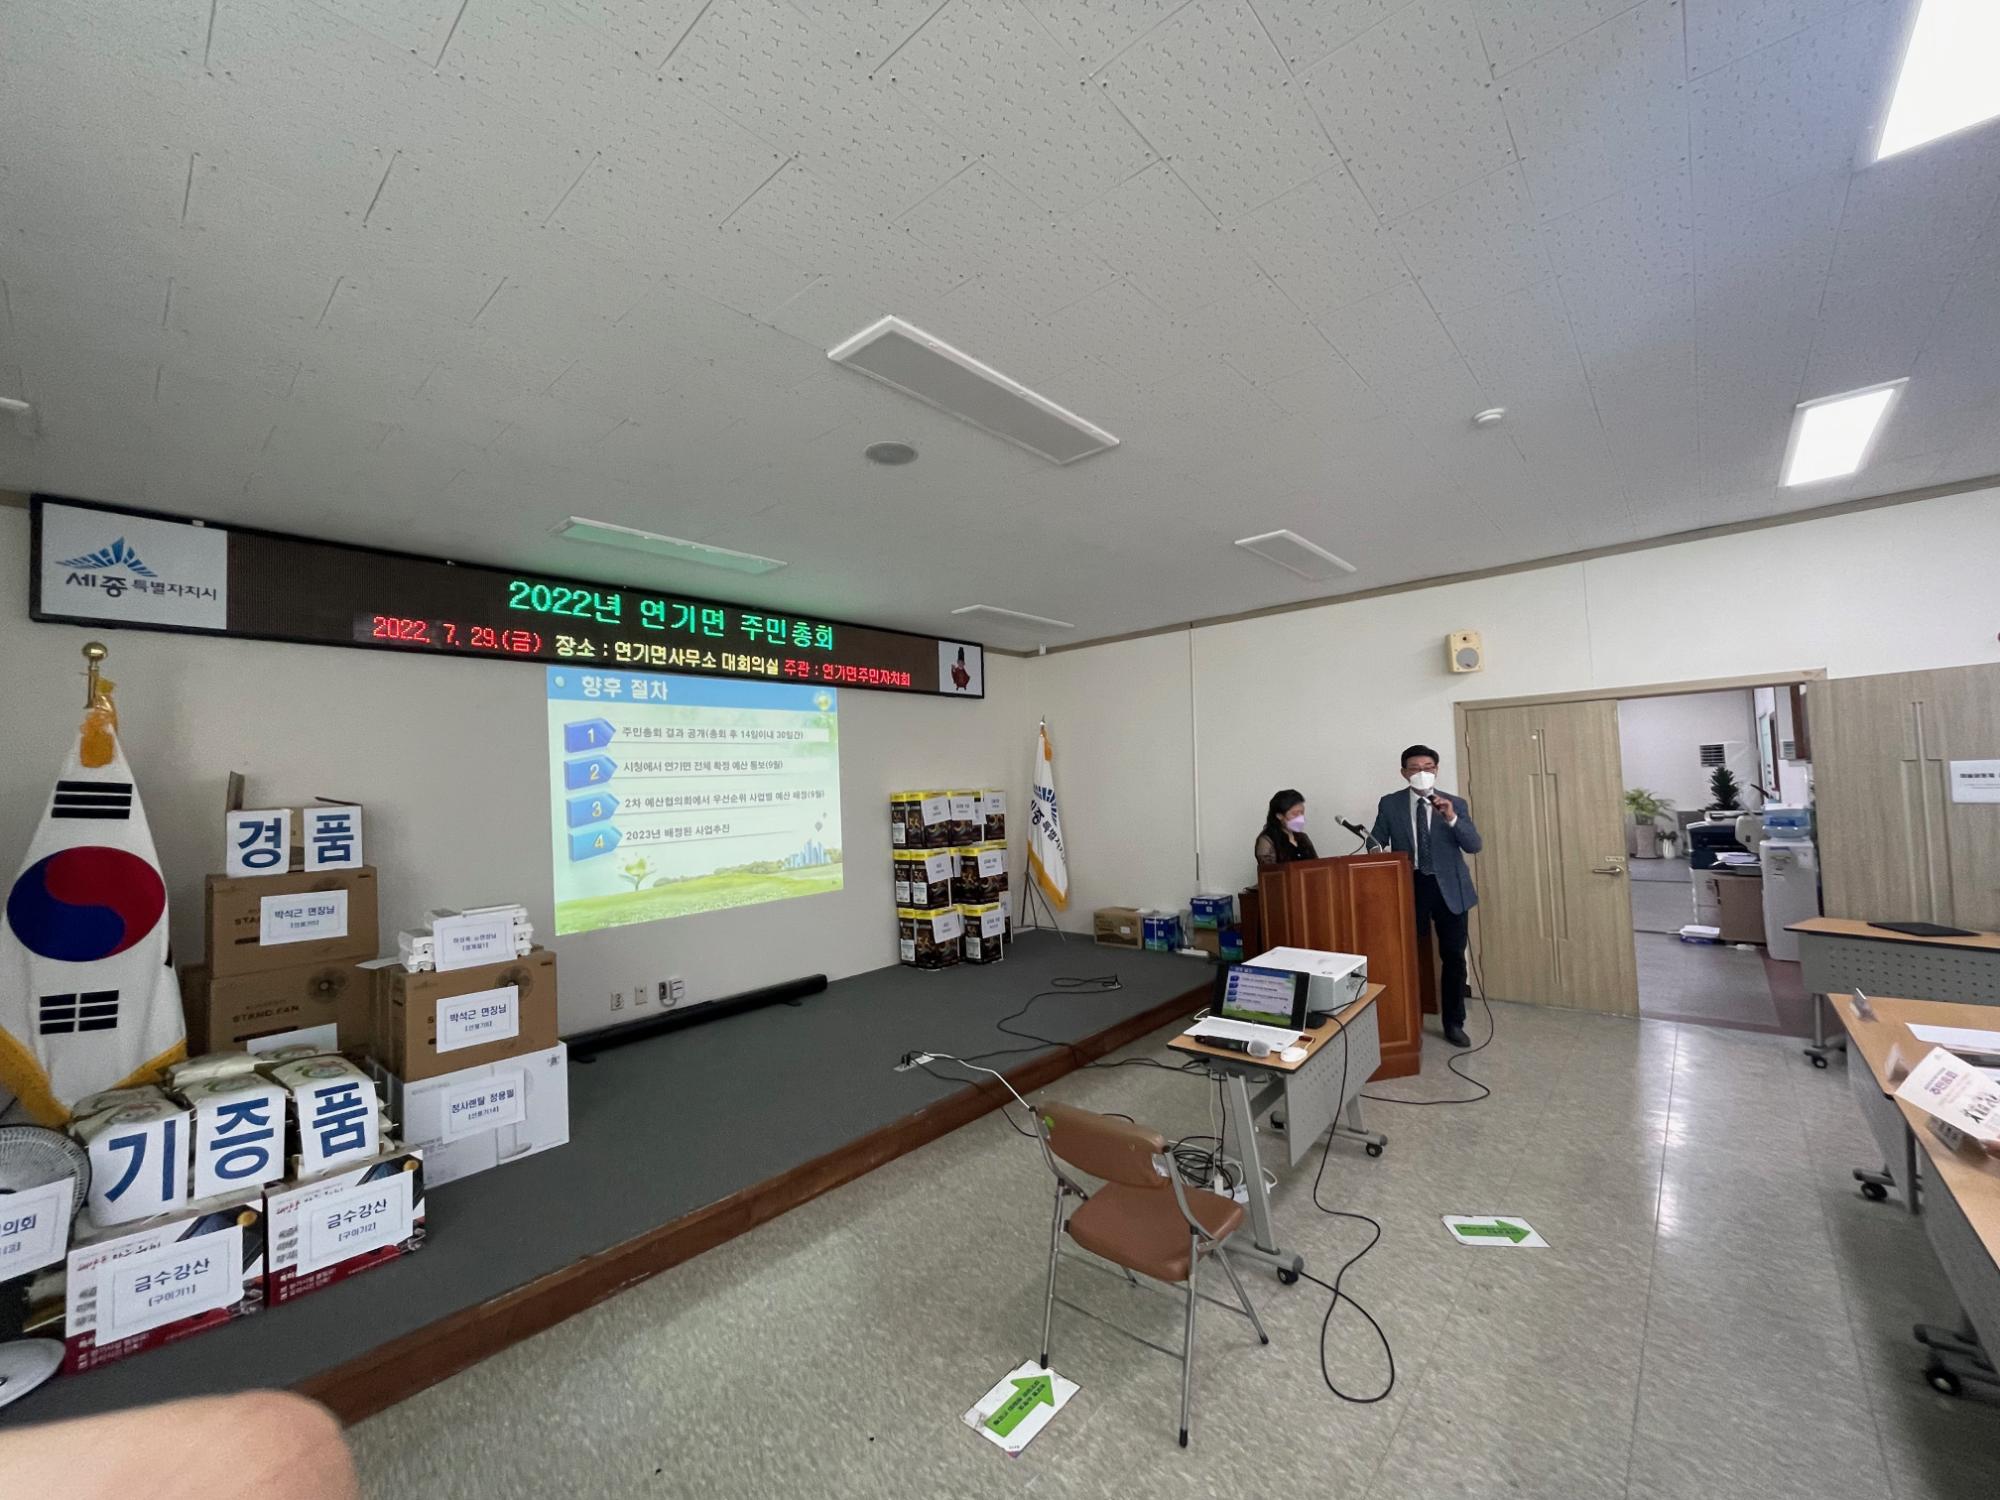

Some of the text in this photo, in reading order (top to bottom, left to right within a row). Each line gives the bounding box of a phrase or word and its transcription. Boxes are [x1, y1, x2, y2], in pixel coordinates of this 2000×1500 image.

[66, 573, 128, 598] 세종
[509, 581, 833, 650] 2022년 연기면 주민총회
[373, 616, 430, 643] 2022.
[443, 624, 461, 646] 7.
[555, 634, 596, 657] 장소
[614, 641, 717, 669] 연기면사무소
[722, 652, 779, 675] 대회의실
[784, 659, 810, 678] 주관
[822, 663, 911, 687] 연기면주민자치회
[581, 676, 668, 701] 향후 절차
[587, 727, 595, 744] 1
[590, 763, 600, 780] 2
[592, 801, 602, 817] 3
[238, 814, 354, 869] 경품
[594, 833, 604, 849] 4
[626, 829, 661, 841] 2023년
[104, 1081, 369, 1204] 기증품
[0, 1213, 37, 1237] 의회
[326, 1198, 387, 1230] 금수강산
[135, 1258, 211, 1293] 금수강산
